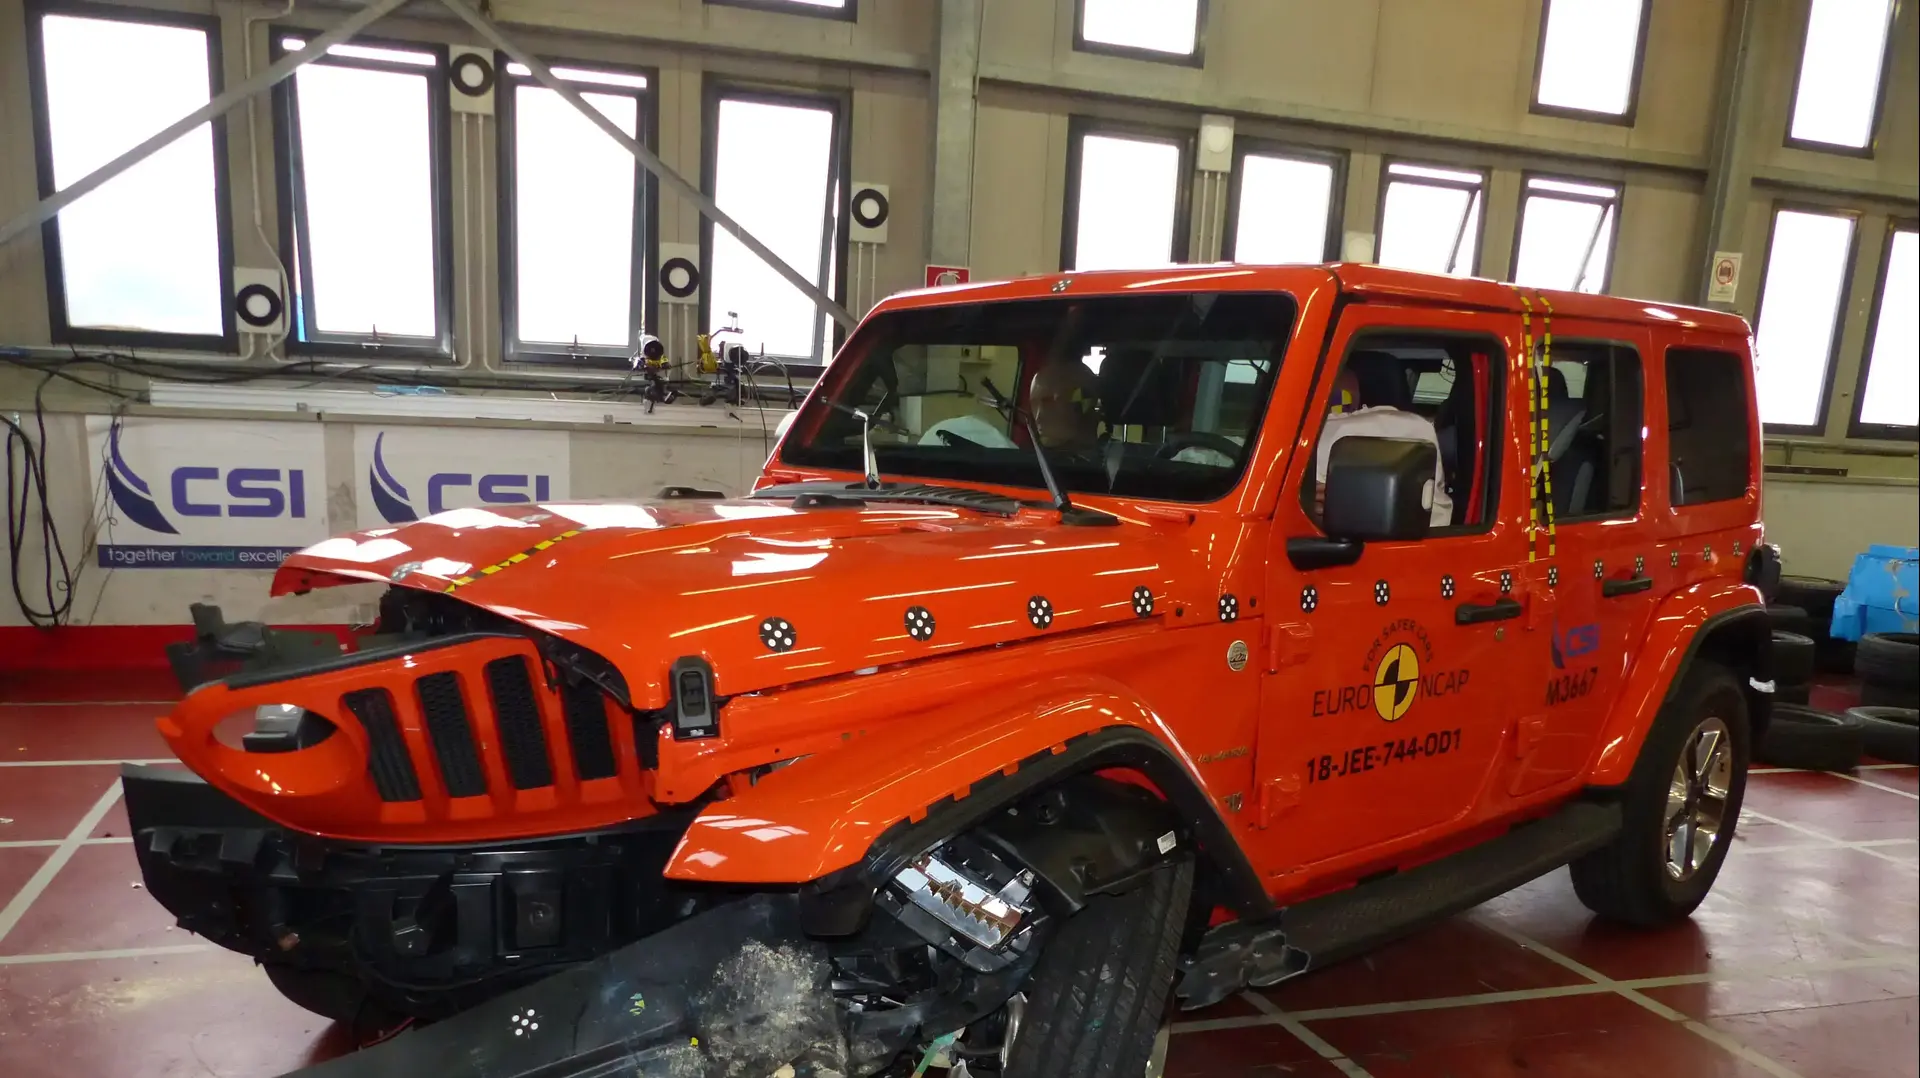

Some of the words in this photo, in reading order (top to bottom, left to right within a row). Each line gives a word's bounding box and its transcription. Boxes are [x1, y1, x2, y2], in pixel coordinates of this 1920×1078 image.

[171, 466, 305, 518] CSI
[428, 473, 549, 515] CSI
[108, 548, 176, 564] together
[181, 549, 235, 562] toward
[1363, 637, 1382, 672] FOR
[1383, 618, 1416, 639] SAFER
[1416, 626, 1434, 663] CARS
[1565, 622, 1600, 658] CSI
[1312, 684, 1370, 717] EURO
[1420, 669, 1469, 698] NCAP
[1544, 666, 1599, 706] M3667
